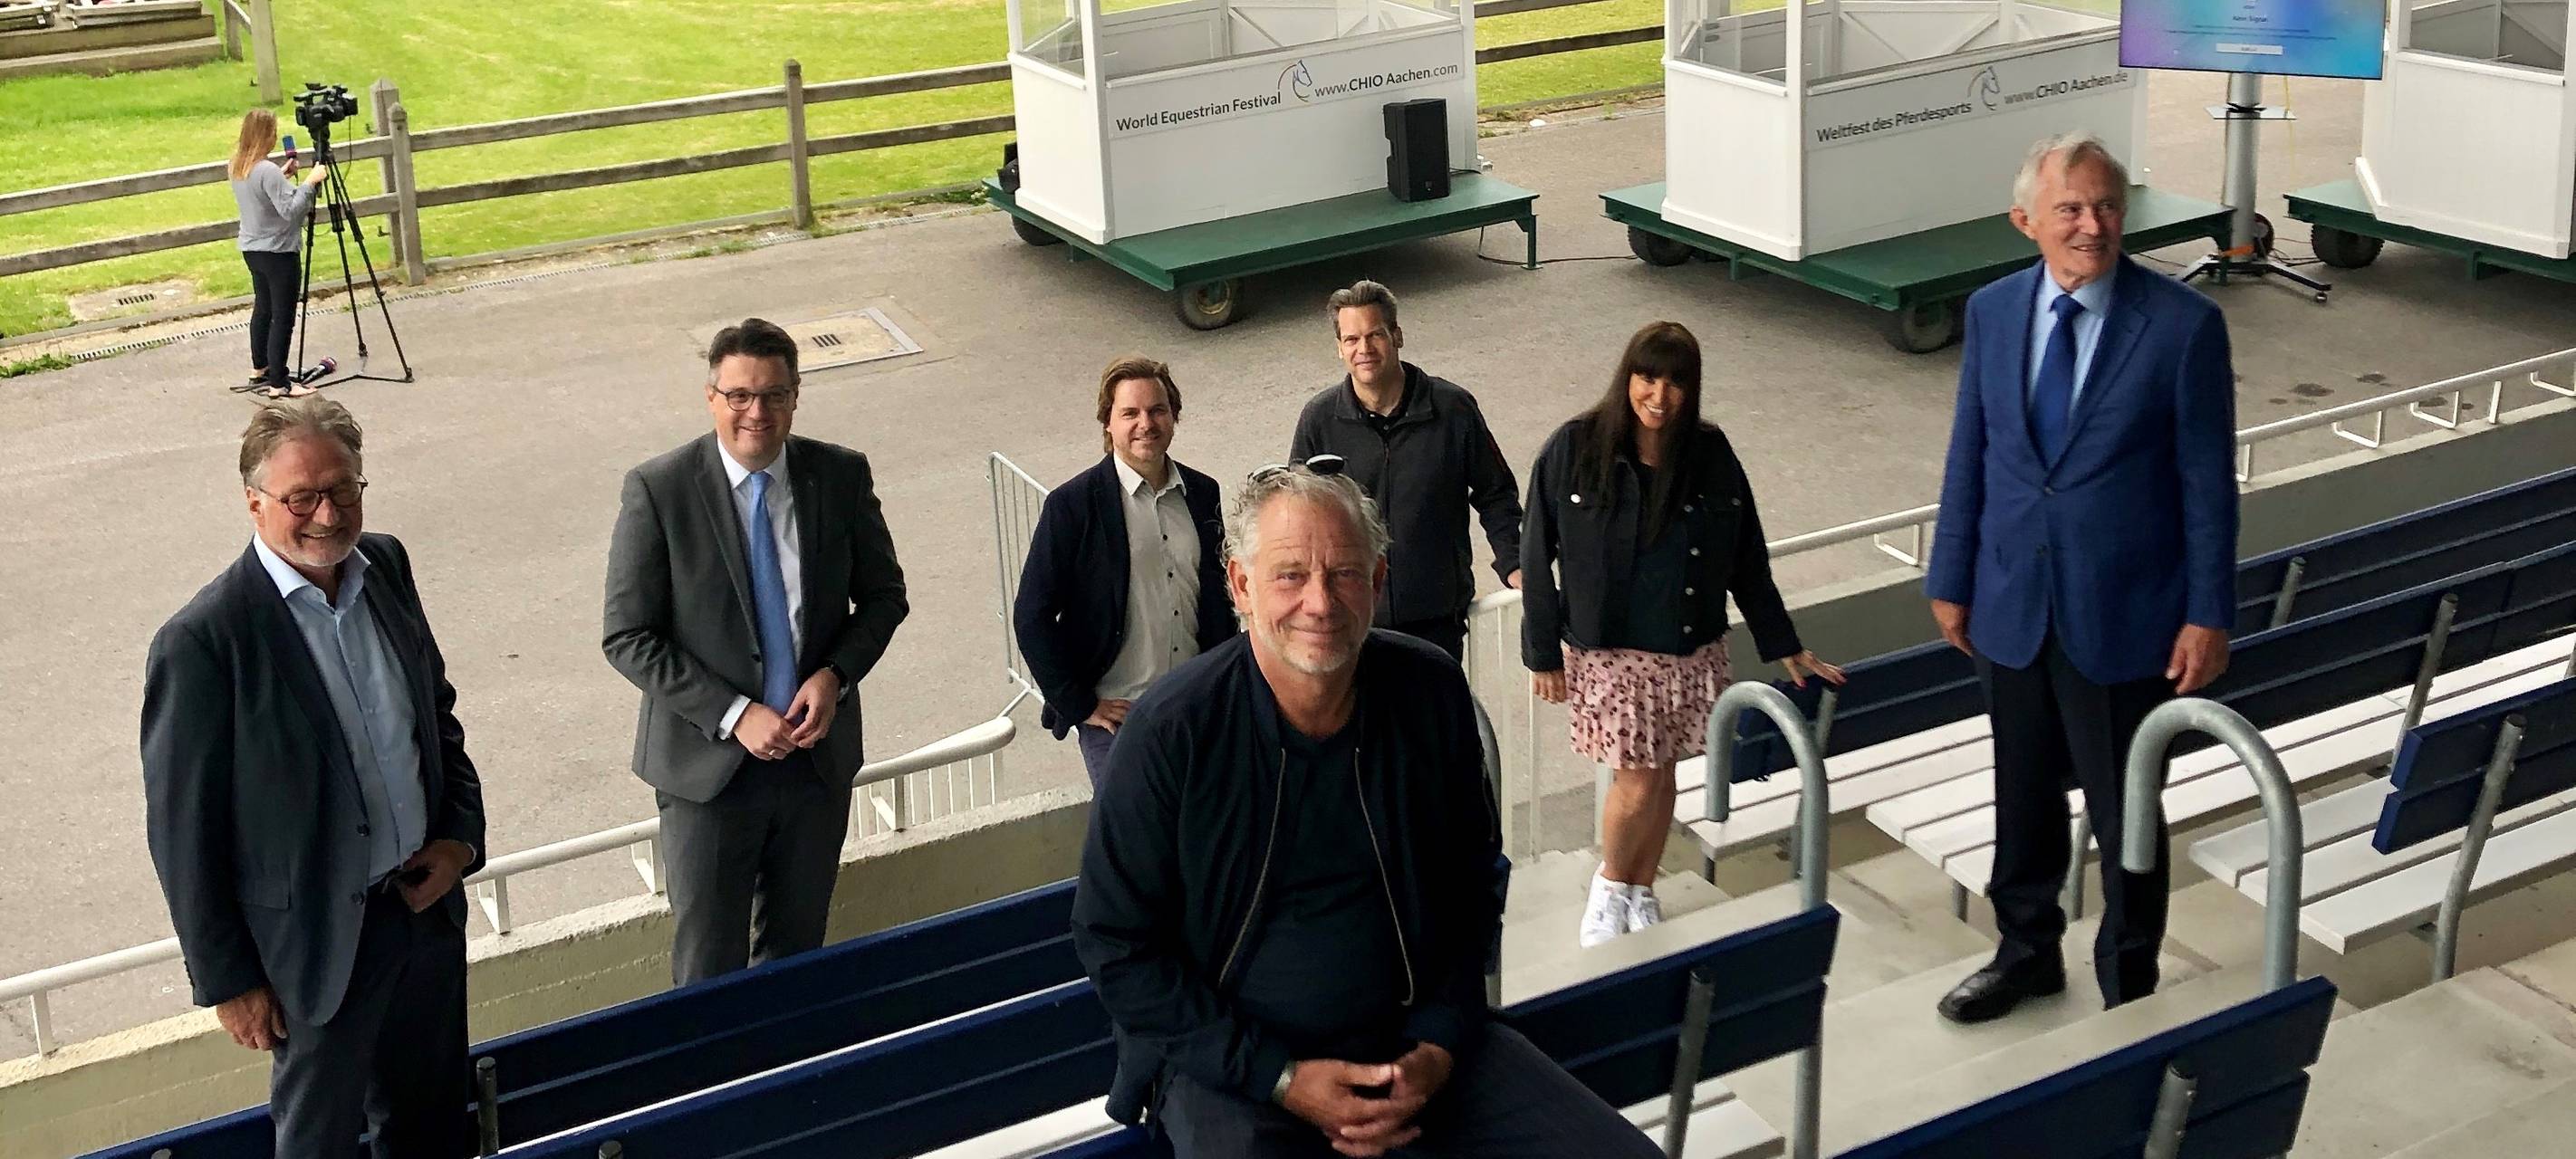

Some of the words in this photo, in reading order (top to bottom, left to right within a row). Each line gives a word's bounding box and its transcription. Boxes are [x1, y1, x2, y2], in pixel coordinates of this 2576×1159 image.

[1116, 112, 1158, 131] World
[1161, 102, 1230, 125] Equestrian
[1233, 91, 1281, 111] Festival
[1314, 74, 1383, 97] www.CHIO
[1386, 64, 1457, 86] Aachen.com
[1816, 120, 1870, 142] Weltfest
[1872, 117, 1894, 131] des
[1896, 102, 1972, 127] Pferdesports
[2004, 81, 2069, 104] www.CHIO
[2071, 71, 2128, 92] Aachen.de
